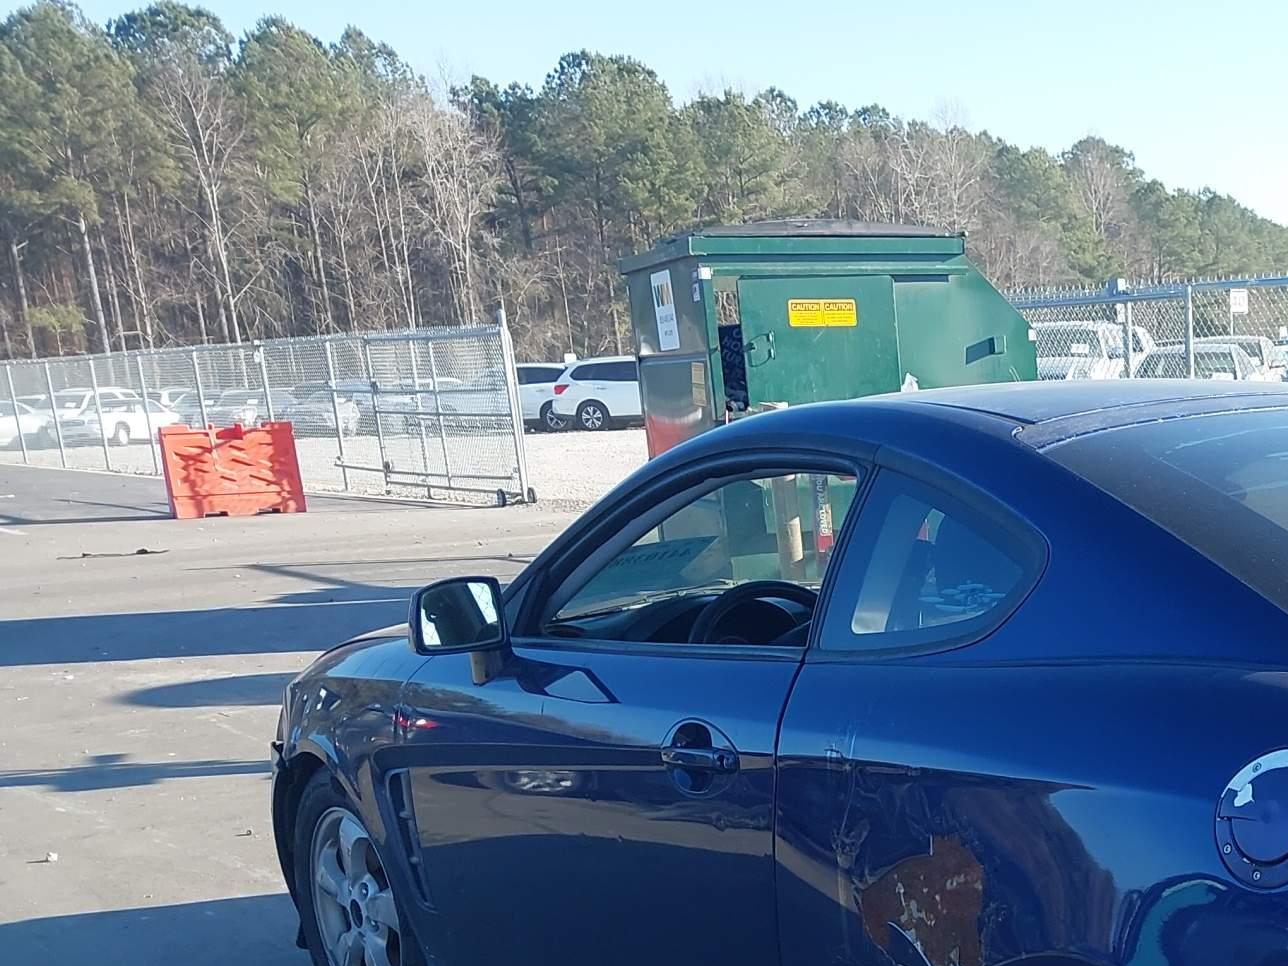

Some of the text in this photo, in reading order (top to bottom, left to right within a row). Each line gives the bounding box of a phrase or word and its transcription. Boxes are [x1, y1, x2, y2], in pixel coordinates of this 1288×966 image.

[791, 303, 820, 311] CAUTION
[825, 302, 853, 310] CAUTION
[819, 509, 828, 534] LOVED
